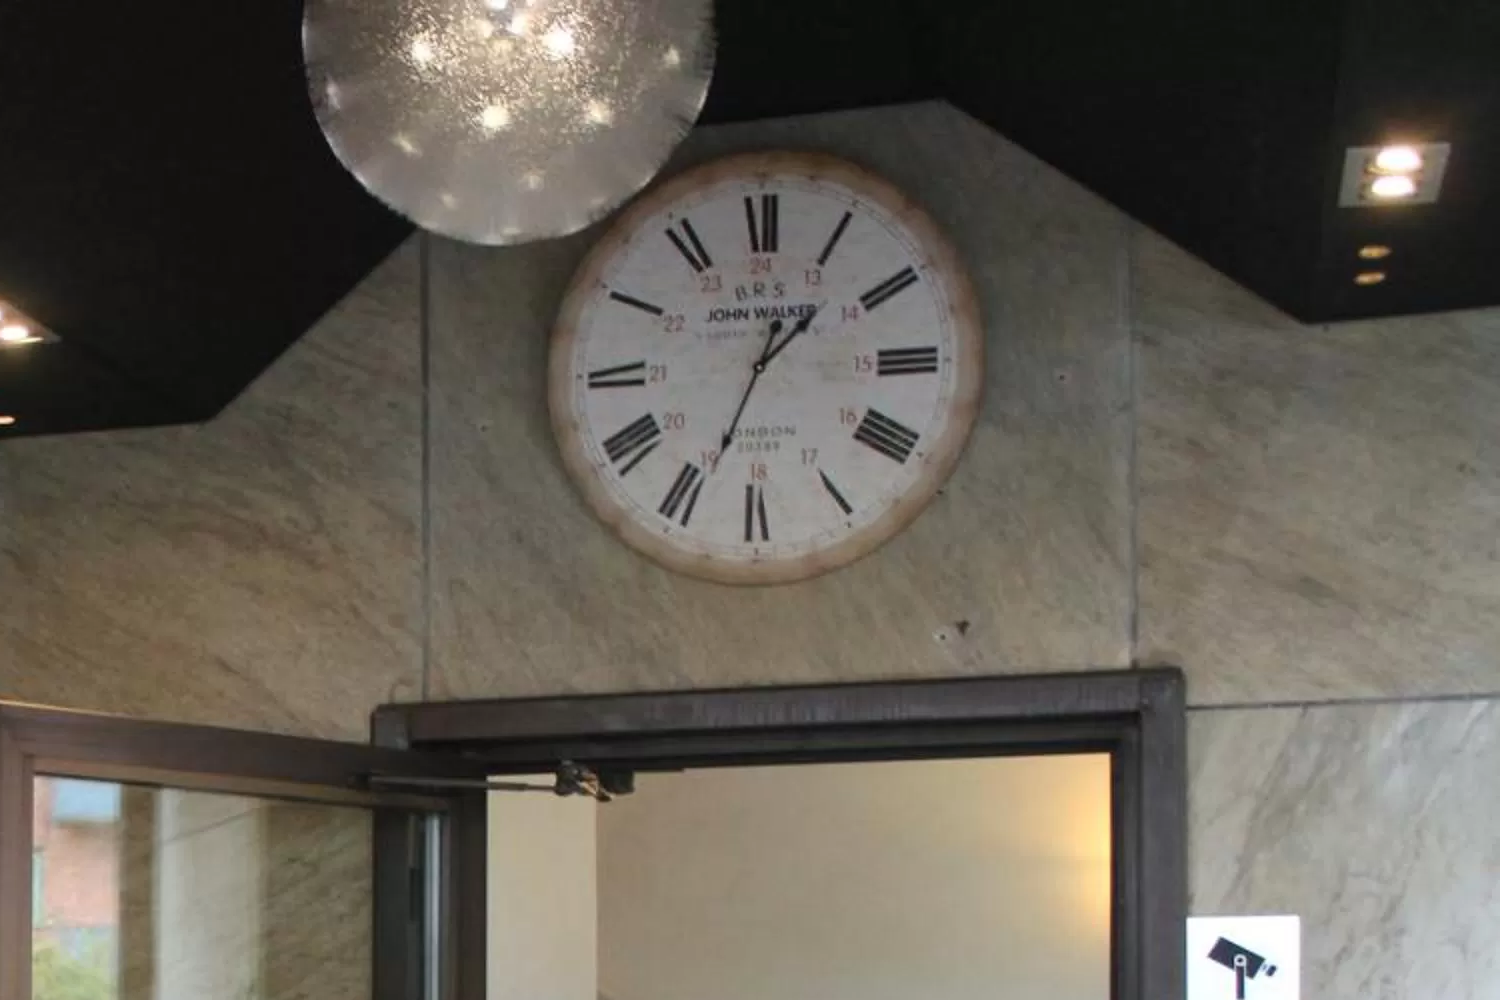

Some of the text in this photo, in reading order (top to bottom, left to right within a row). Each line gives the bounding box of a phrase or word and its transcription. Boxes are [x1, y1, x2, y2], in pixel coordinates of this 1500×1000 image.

[749, 258, 773, 275] 24
[702, 275, 723, 293] 23
[804, 270, 822, 288] 13
[706, 307, 750, 324] JOHN
[841, 305, 859, 323] 14
[664, 315, 686, 334] 22
[650, 365, 668, 382] 21
[854, 356, 872, 373] 15
[664, 413, 686, 431] 20
[839, 408, 857, 425] 16
[801, 448, 818, 466] 17
[749, 462, 768, 480] 18
